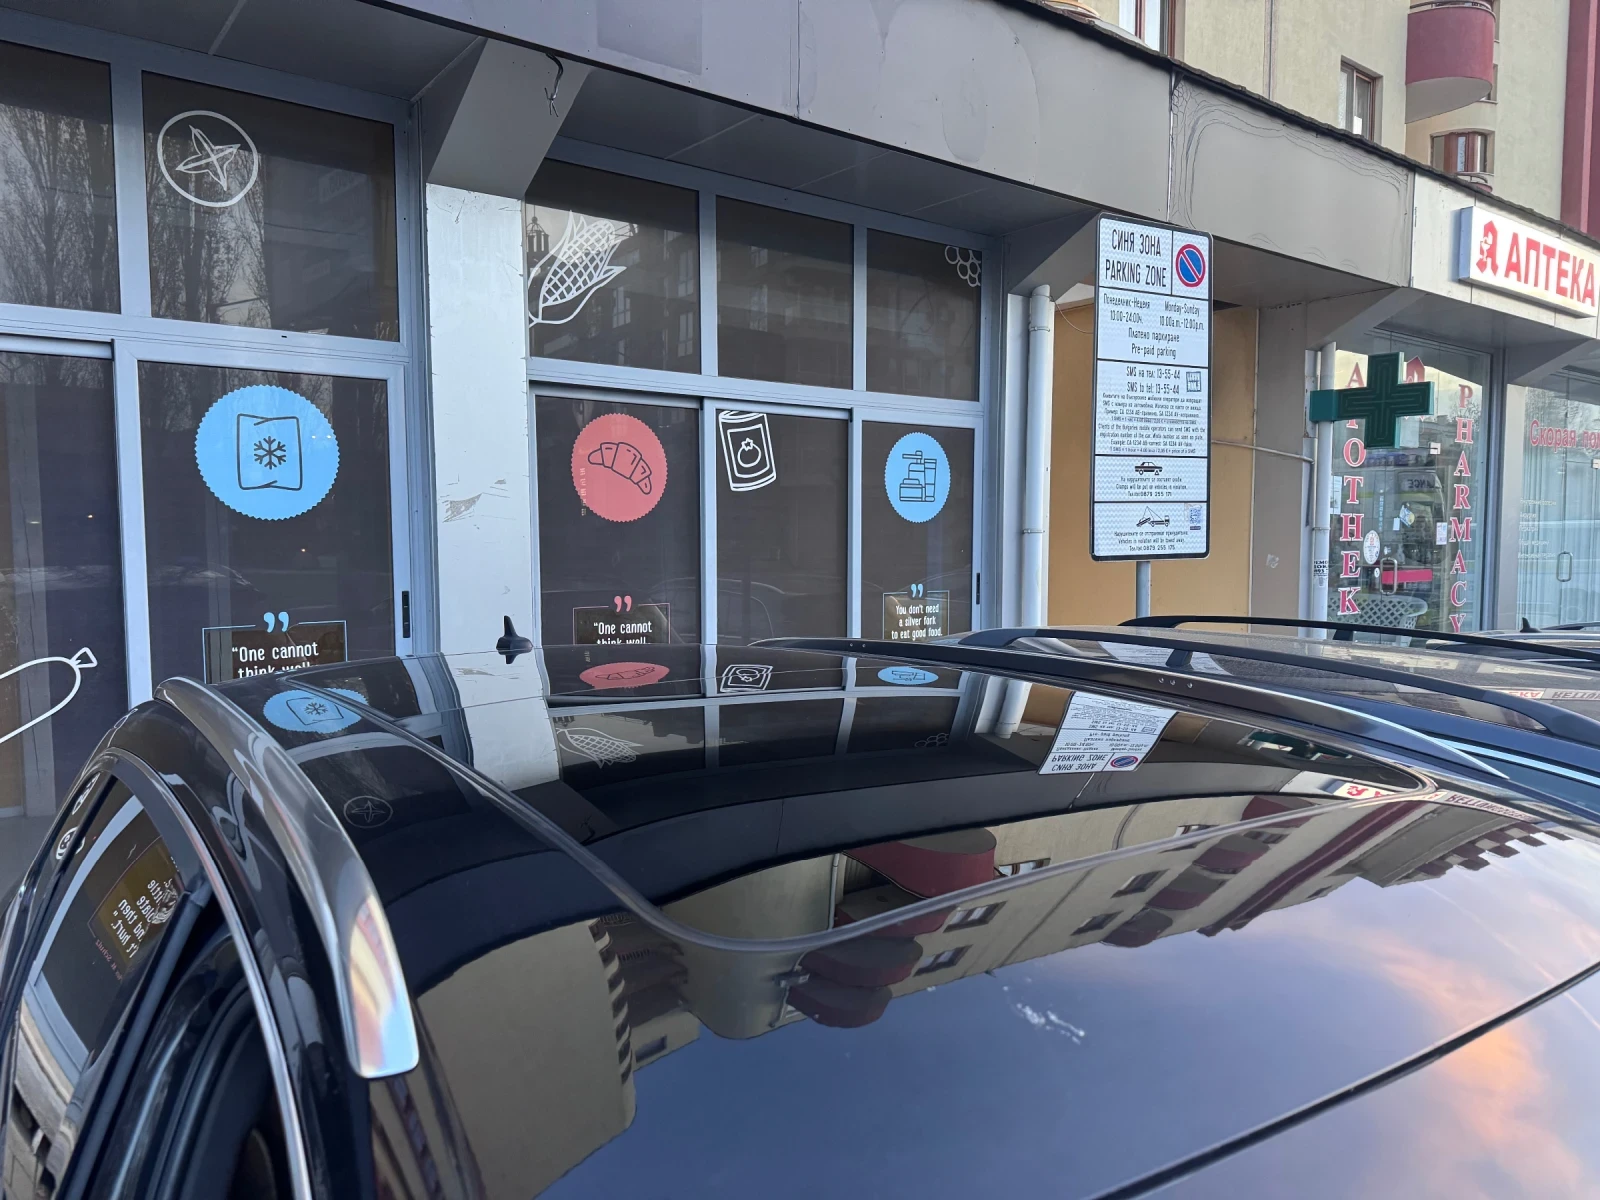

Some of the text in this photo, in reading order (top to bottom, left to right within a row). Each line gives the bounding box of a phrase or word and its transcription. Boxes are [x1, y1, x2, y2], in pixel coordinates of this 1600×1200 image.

[1112, 229, 1161, 256] СИНЯ ЗОНА
[1106, 259, 1166, 287] PARKING ZONE
[1504, 232, 1594, 307] АПТЕКА
[1164, 300, 1200, 316] Monday-Sunday
[1128, 328, 1180, 343] Платено паркиране
[1132, 343, 1176, 359] Pre-paid parking
[1126, 366, 1136, 376] SMS
[1157, 368, 1180, 380] 13-55-44
[1127, 382, 1137, 392] SMS
[1140, 382, 1144, 392] to
[1156, 384, 1179, 394] 13-55-44
[1530, 419, 1576, 453] Скорая
[896, 604, 939, 614] You don't need
[620, 621, 652, 634] cannot
[905, 617, 922, 626] silver
[924, 616, 936, 625] fork
[892, 627, 942, 641] to eat good food.
[272, 642, 319, 659] cannot
